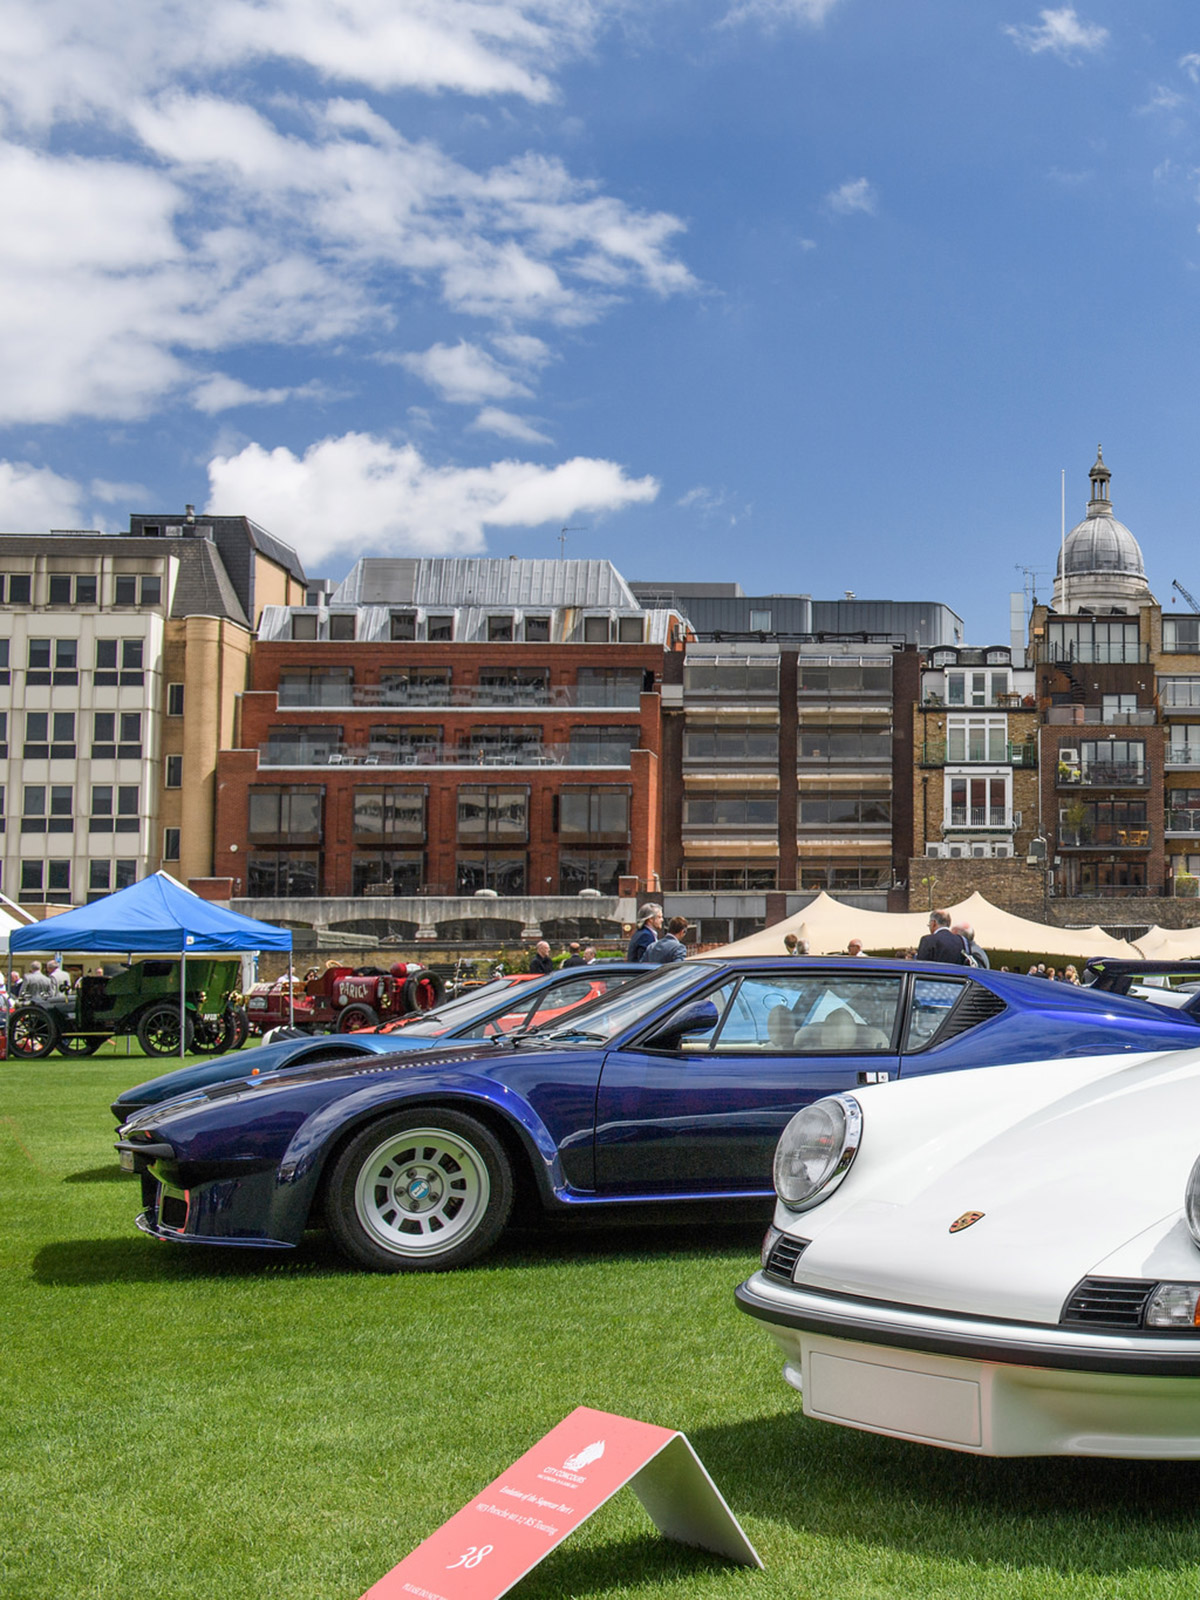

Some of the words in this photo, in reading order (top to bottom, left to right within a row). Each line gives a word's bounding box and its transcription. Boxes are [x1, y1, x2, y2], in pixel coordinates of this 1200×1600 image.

[486, 1504, 510, 1518] Porsche
[533, 1519, 559, 1536] Touring
[445, 1544, 494, 1569] 38
